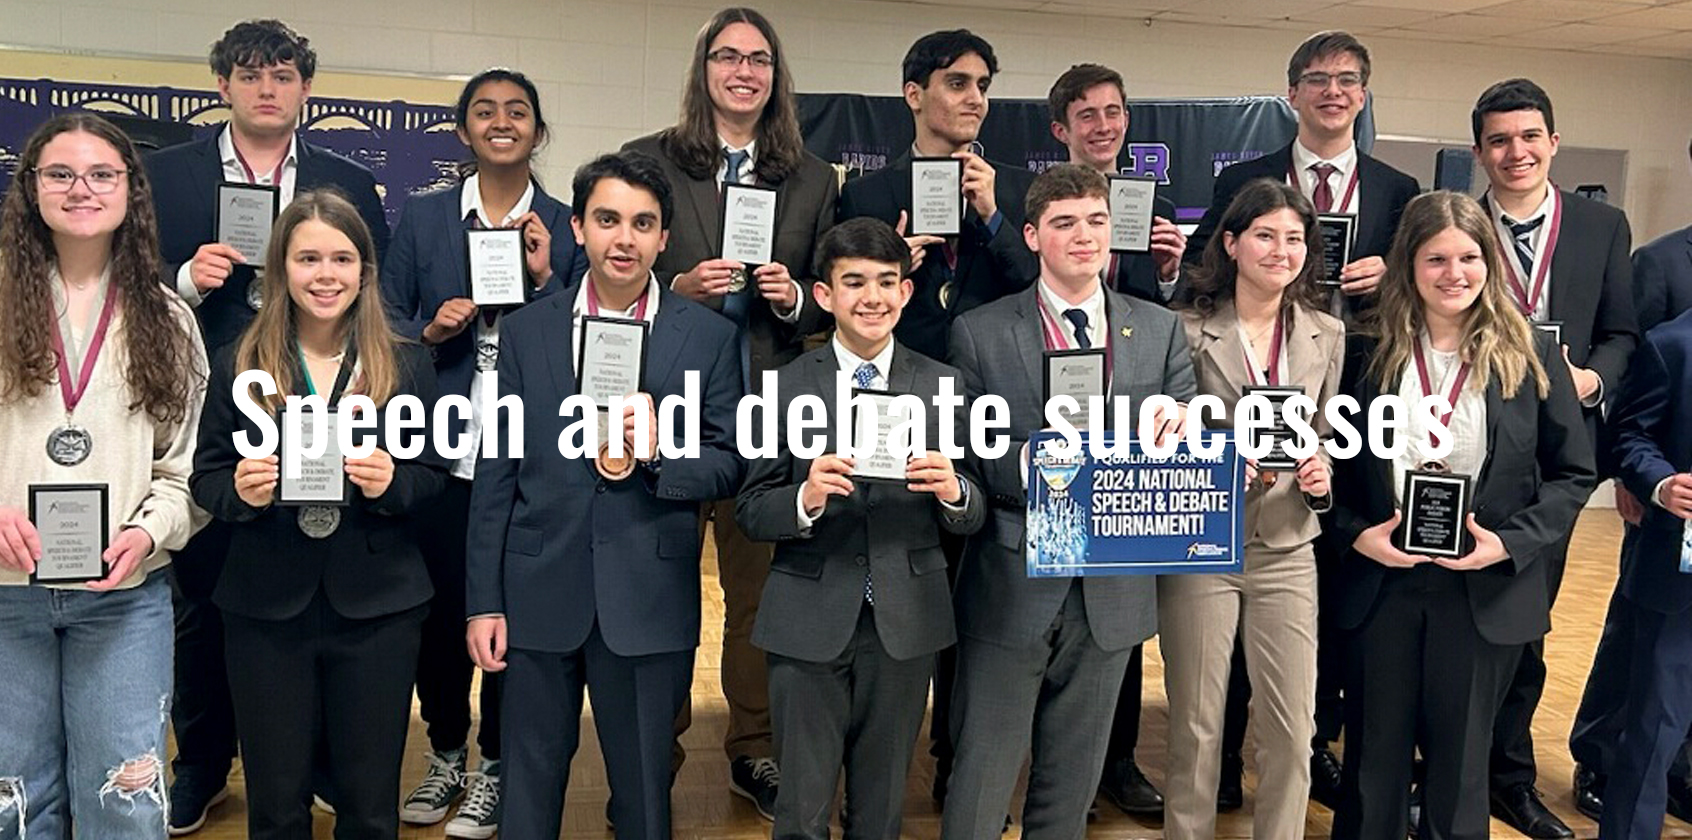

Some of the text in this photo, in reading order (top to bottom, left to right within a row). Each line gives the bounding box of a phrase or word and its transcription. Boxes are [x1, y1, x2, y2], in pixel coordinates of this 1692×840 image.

[1171, 453, 1197, 464] FOR
[1093, 468, 1216, 490] 2024 NATIONAL
[1092, 491, 1229, 514] SPEECH & DEBATE
[1092, 514, 1205, 536] TOURNAMENT!
